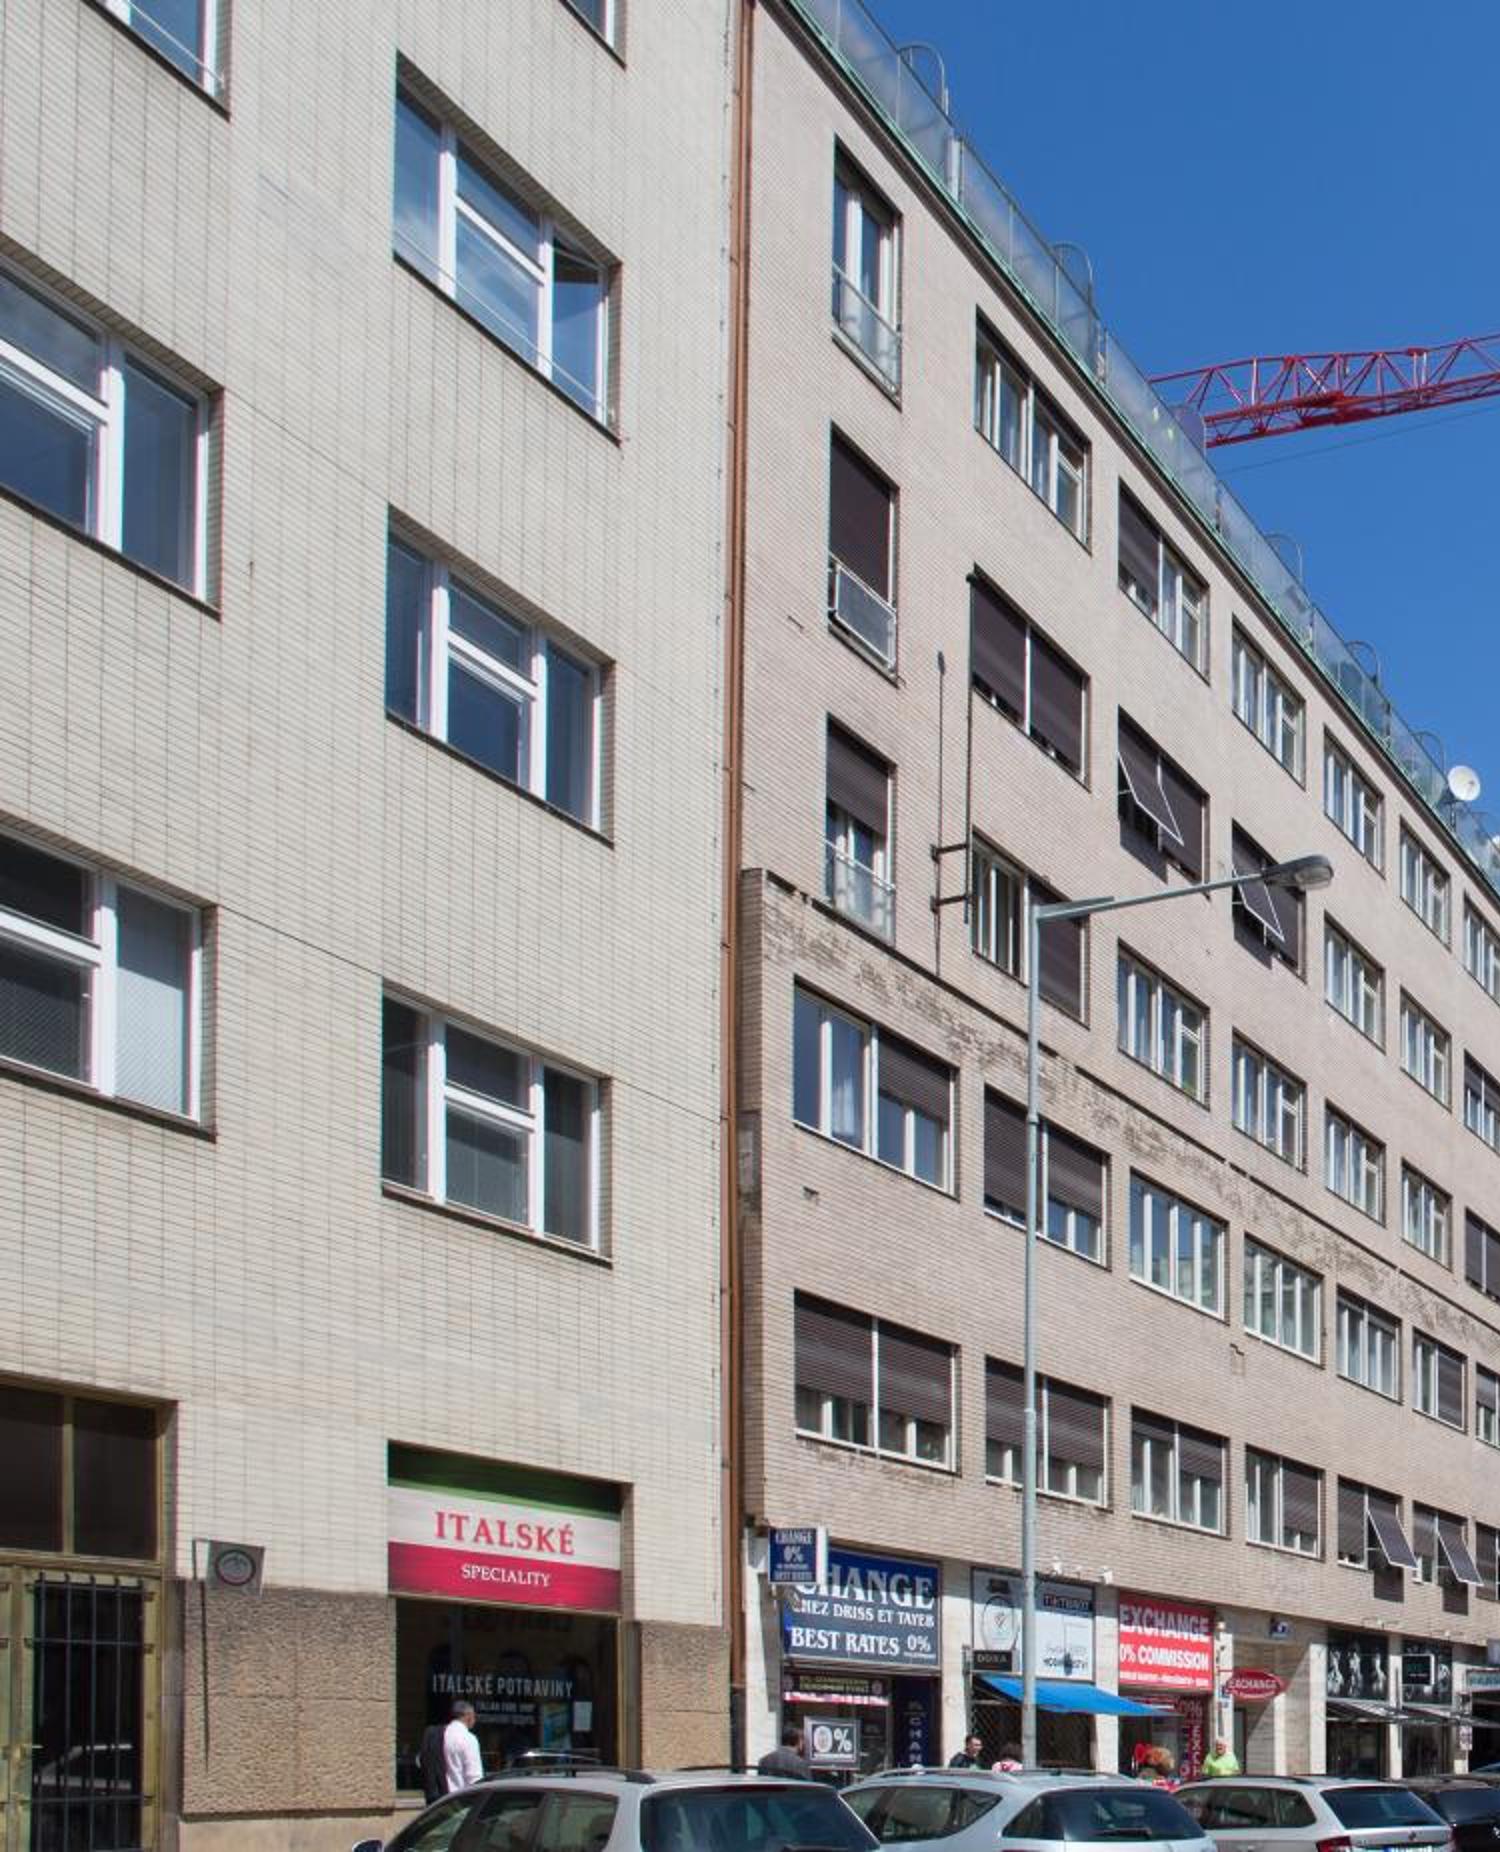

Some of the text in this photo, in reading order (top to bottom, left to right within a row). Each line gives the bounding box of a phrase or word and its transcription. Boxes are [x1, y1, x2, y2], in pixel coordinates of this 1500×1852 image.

[434, 1510, 576, 1555] ITALSKÉ
[461, 1562, 552, 1588] SPECIALITY
[795, 1563, 935, 1610] HANGE
[832, 1602, 874, 1623] DRISS
[877, 1609, 894, 1624] ET
[1119, 1603, 1210, 1643] EXCHANGE
[791, 1626, 932, 1657] BEST RATES 0%
[1119, 1642, 1210, 1672] 0% COMMISSION
[432, 1671, 574, 1698] ITALSKÉ POTRAVINY
[813, 1724, 853, 1754] 0%
